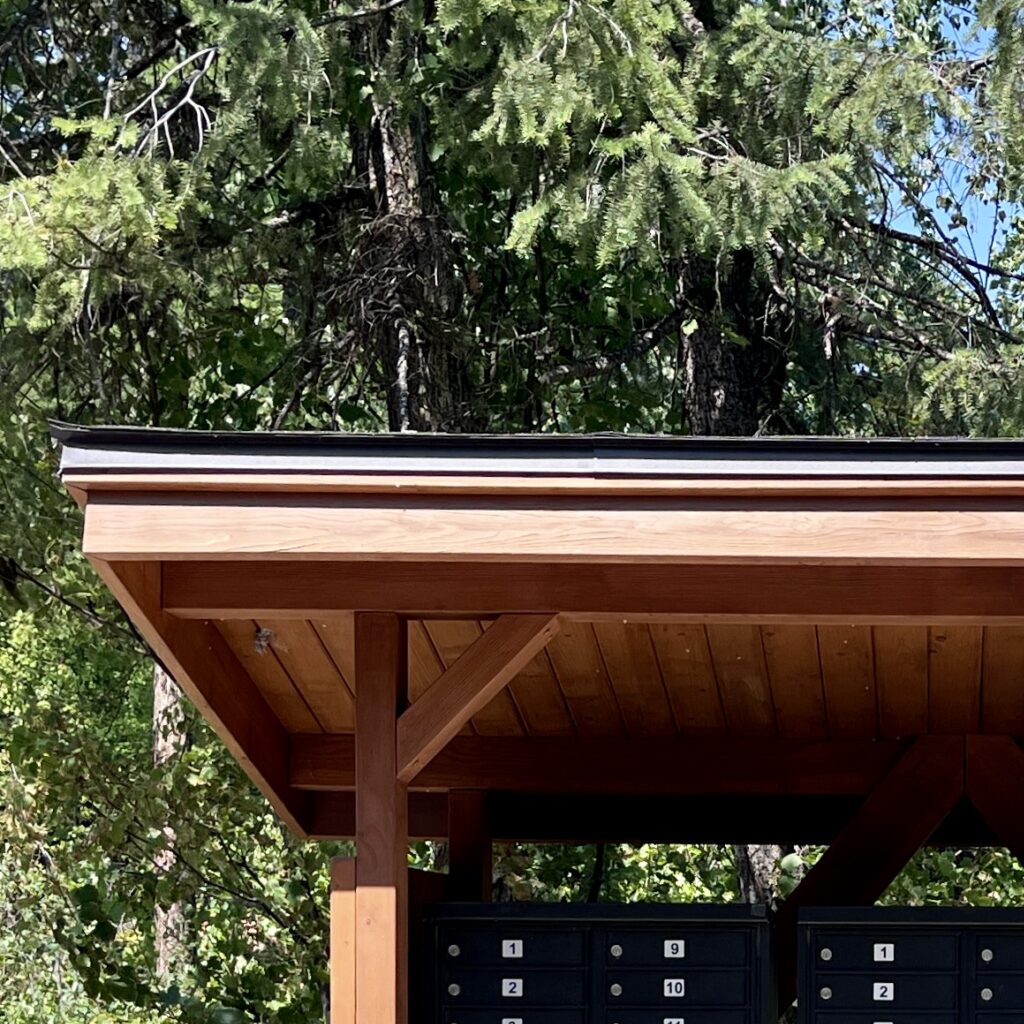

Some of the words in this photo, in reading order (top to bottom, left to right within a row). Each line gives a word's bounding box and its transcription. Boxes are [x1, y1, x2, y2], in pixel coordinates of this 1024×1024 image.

[509, 943, 516, 955] 1
[670, 943, 680, 956] 9
[880, 946, 887, 959] 1
[508, 981, 517, 994] 2
[666, 982, 683, 995] 10
[879, 985, 888, 998] 2
